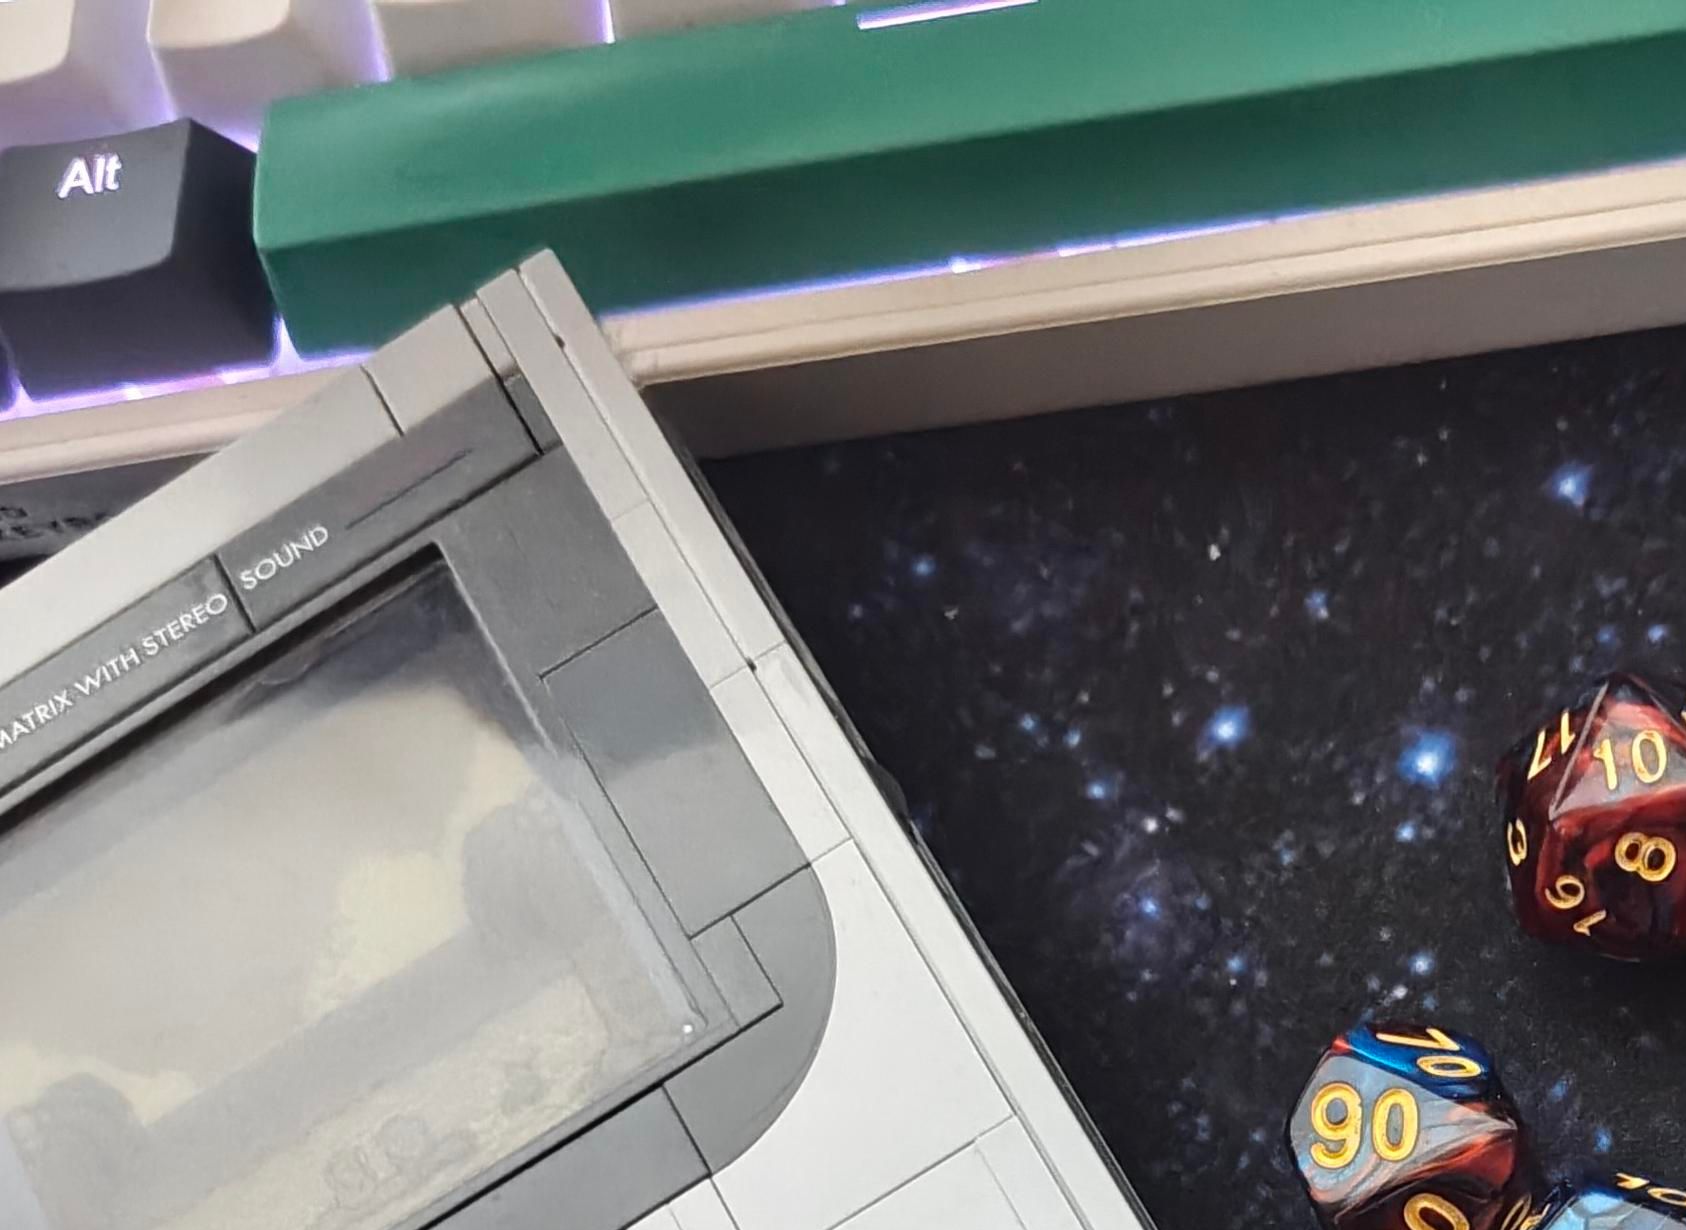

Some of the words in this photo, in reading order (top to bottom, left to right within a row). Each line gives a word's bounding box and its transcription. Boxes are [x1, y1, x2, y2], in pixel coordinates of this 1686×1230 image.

[57, 152, 122, 199] Alt
[74, 645, 140, 697] WITH
[145, 593, 228, 657] STEREO
[239, 525, 329, 591] SOUND
[1593, 729, 1668, 790] 10
[1614, 832, 1677, 882] 8
[1375, 1028, 1482, 1078] 10
[1311, 1082, 1419, 1169] 90
